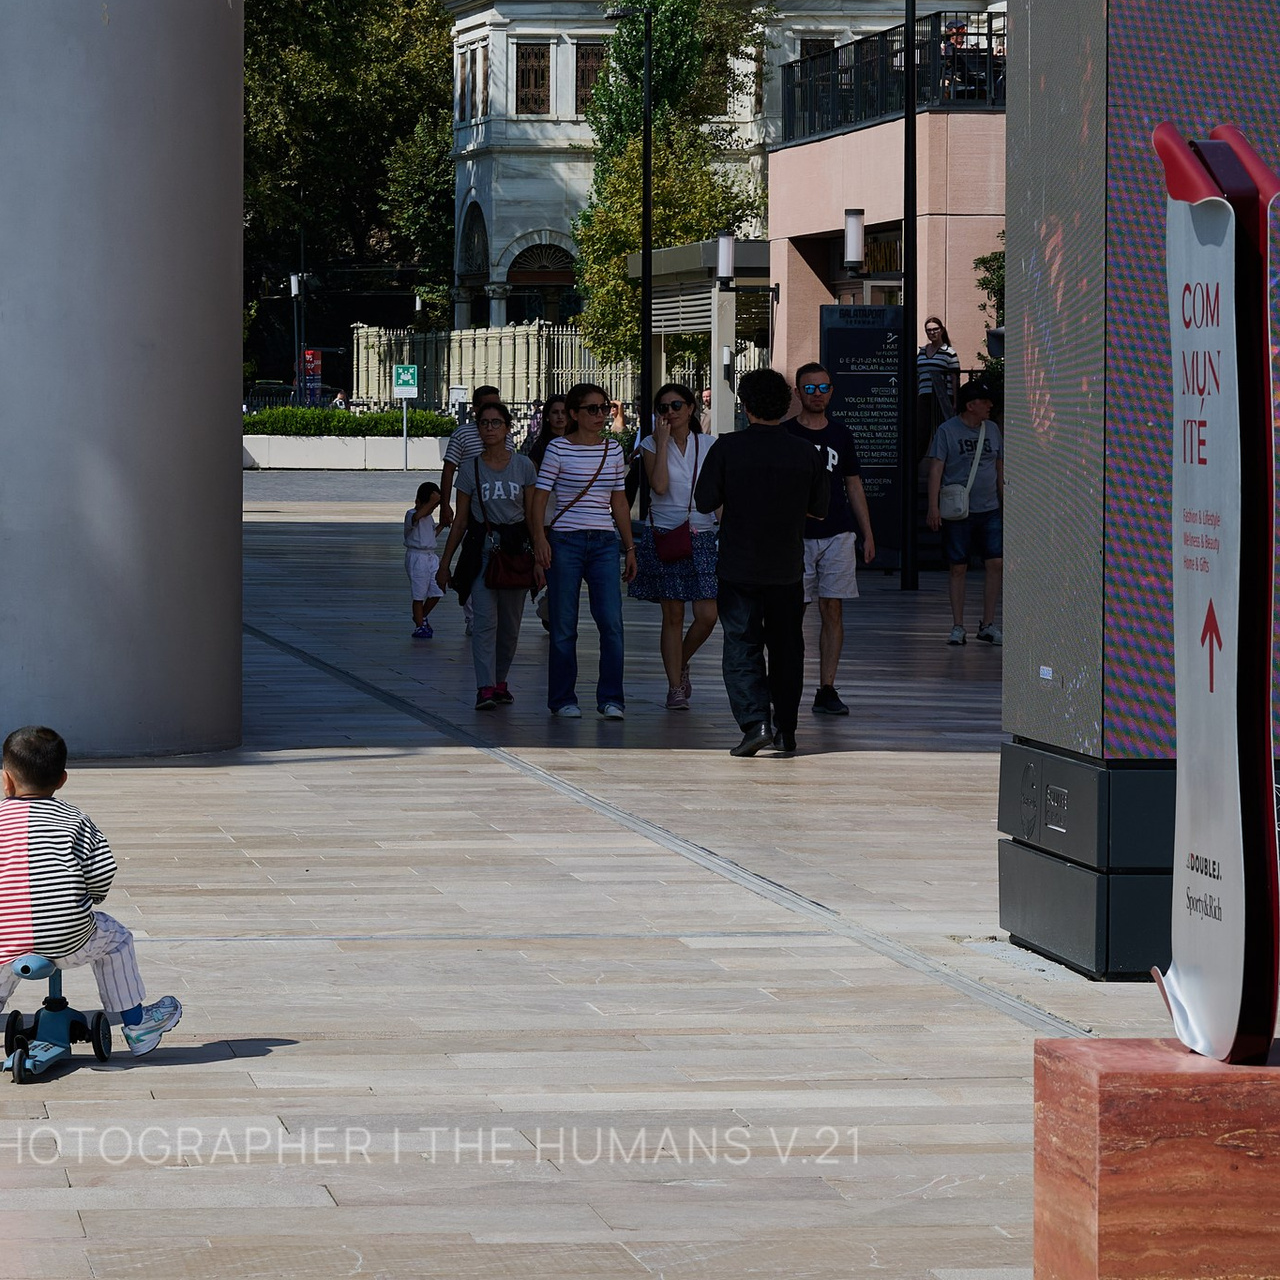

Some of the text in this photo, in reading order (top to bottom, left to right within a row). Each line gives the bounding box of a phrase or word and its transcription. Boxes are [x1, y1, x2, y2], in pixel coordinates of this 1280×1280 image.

[1182, 282, 1220, 329] COM
[1182, 350, 1221, 396] MUN
[481, 481, 520, 502] GAP
[1186, 886, 1222, 922] Sporty&Rich
